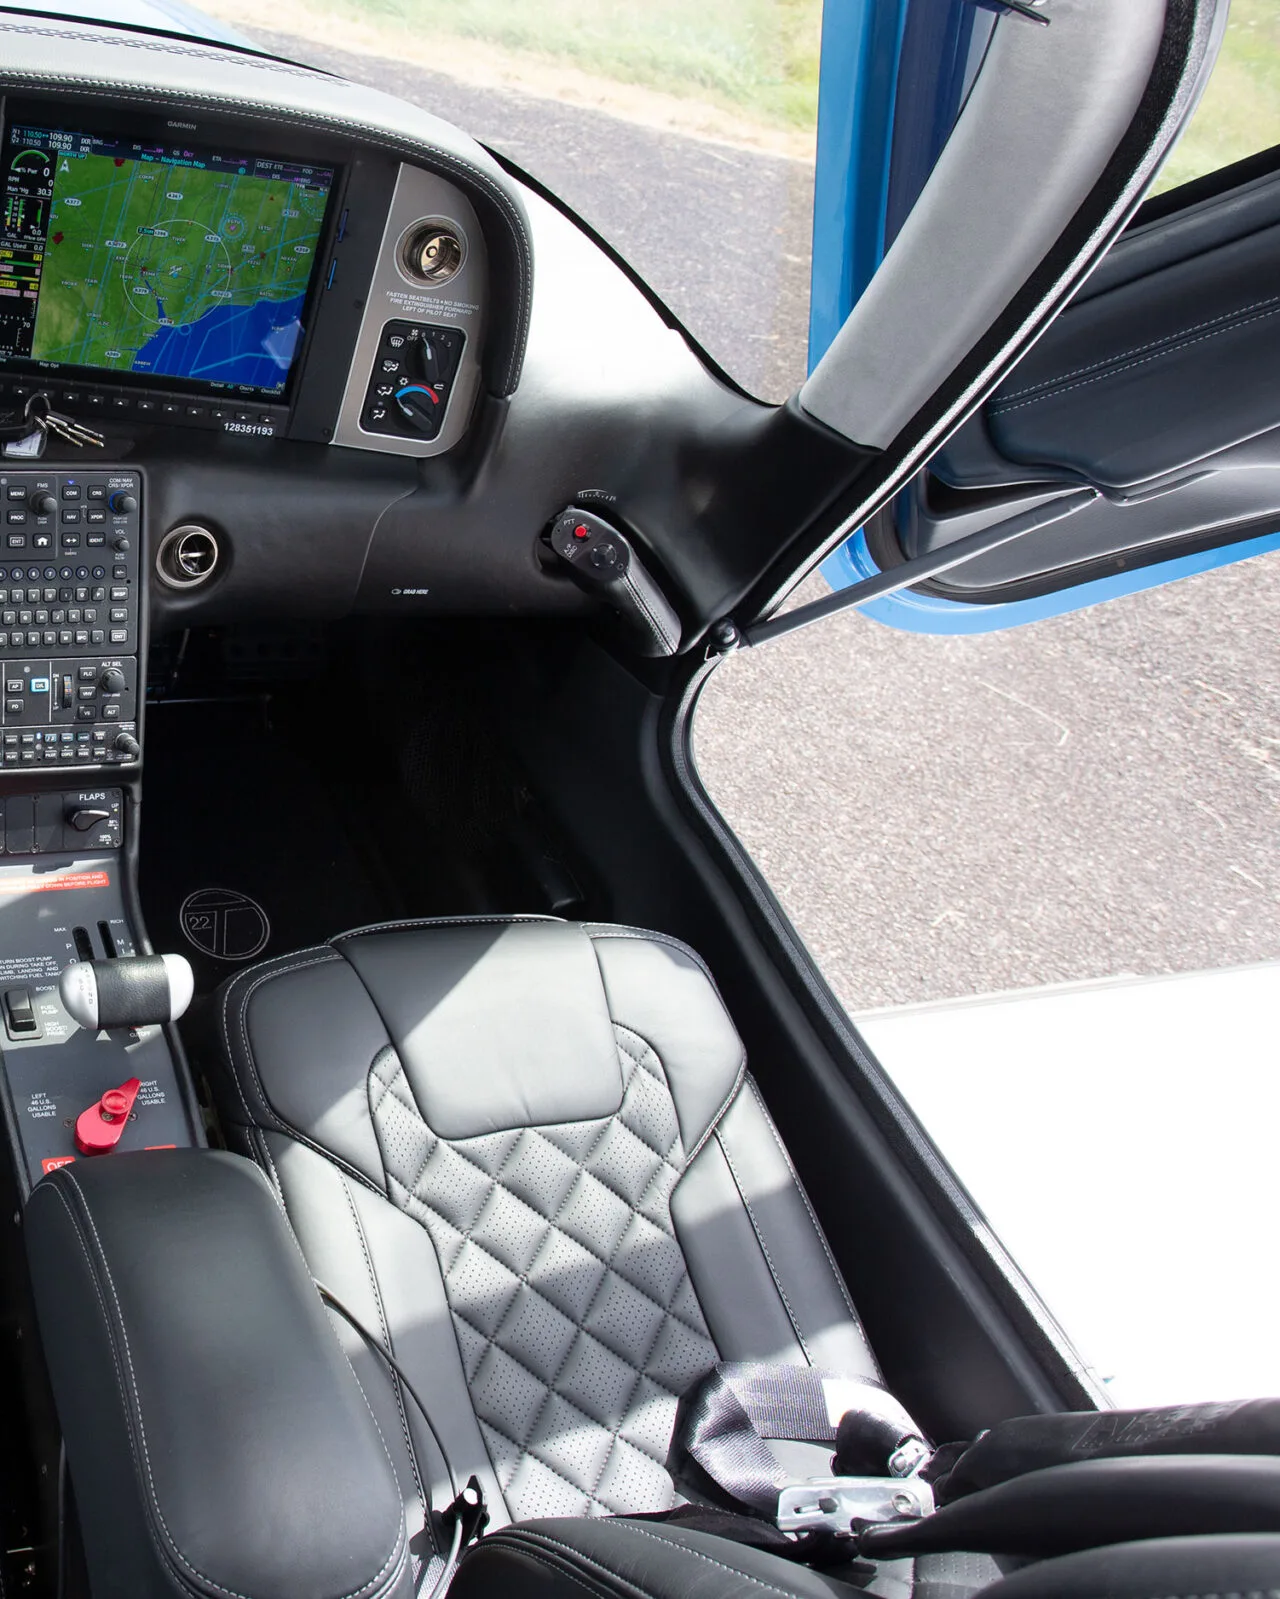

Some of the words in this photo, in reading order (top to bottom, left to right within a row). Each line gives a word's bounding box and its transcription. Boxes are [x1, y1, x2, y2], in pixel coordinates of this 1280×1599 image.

[167, 121, 197, 130] GARMIN
[49, 132, 73, 142] 109.90
[48, 140, 72, 150] 109.90
[141, 153, 154, 161] Map
[161, 156, 192, 166] Navigation
[193, 160, 206, 168] Map
[256, 161, 273, 169] DEST
[43, 167, 50, 177] 0
[37, 188, 52, 196] 30.3
[13, 242, 27, 250] Used
[386, 290, 408, 299] FASTEN
[408, 294, 440, 303] SEATBELTS
[453, 301, 479, 311] SMOKING
[403, 299, 443, 311] EXTINGUISHER
[444, 305, 473, 315] FORWARD
[223, 423, 273, 436] 128351193
[79, 793, 105, 801] FLAPS
[189, 916, 212, 930] 22
[136, 1092, 165, 1100] GALLONS
[46, 1160, 72, 1172] OF
